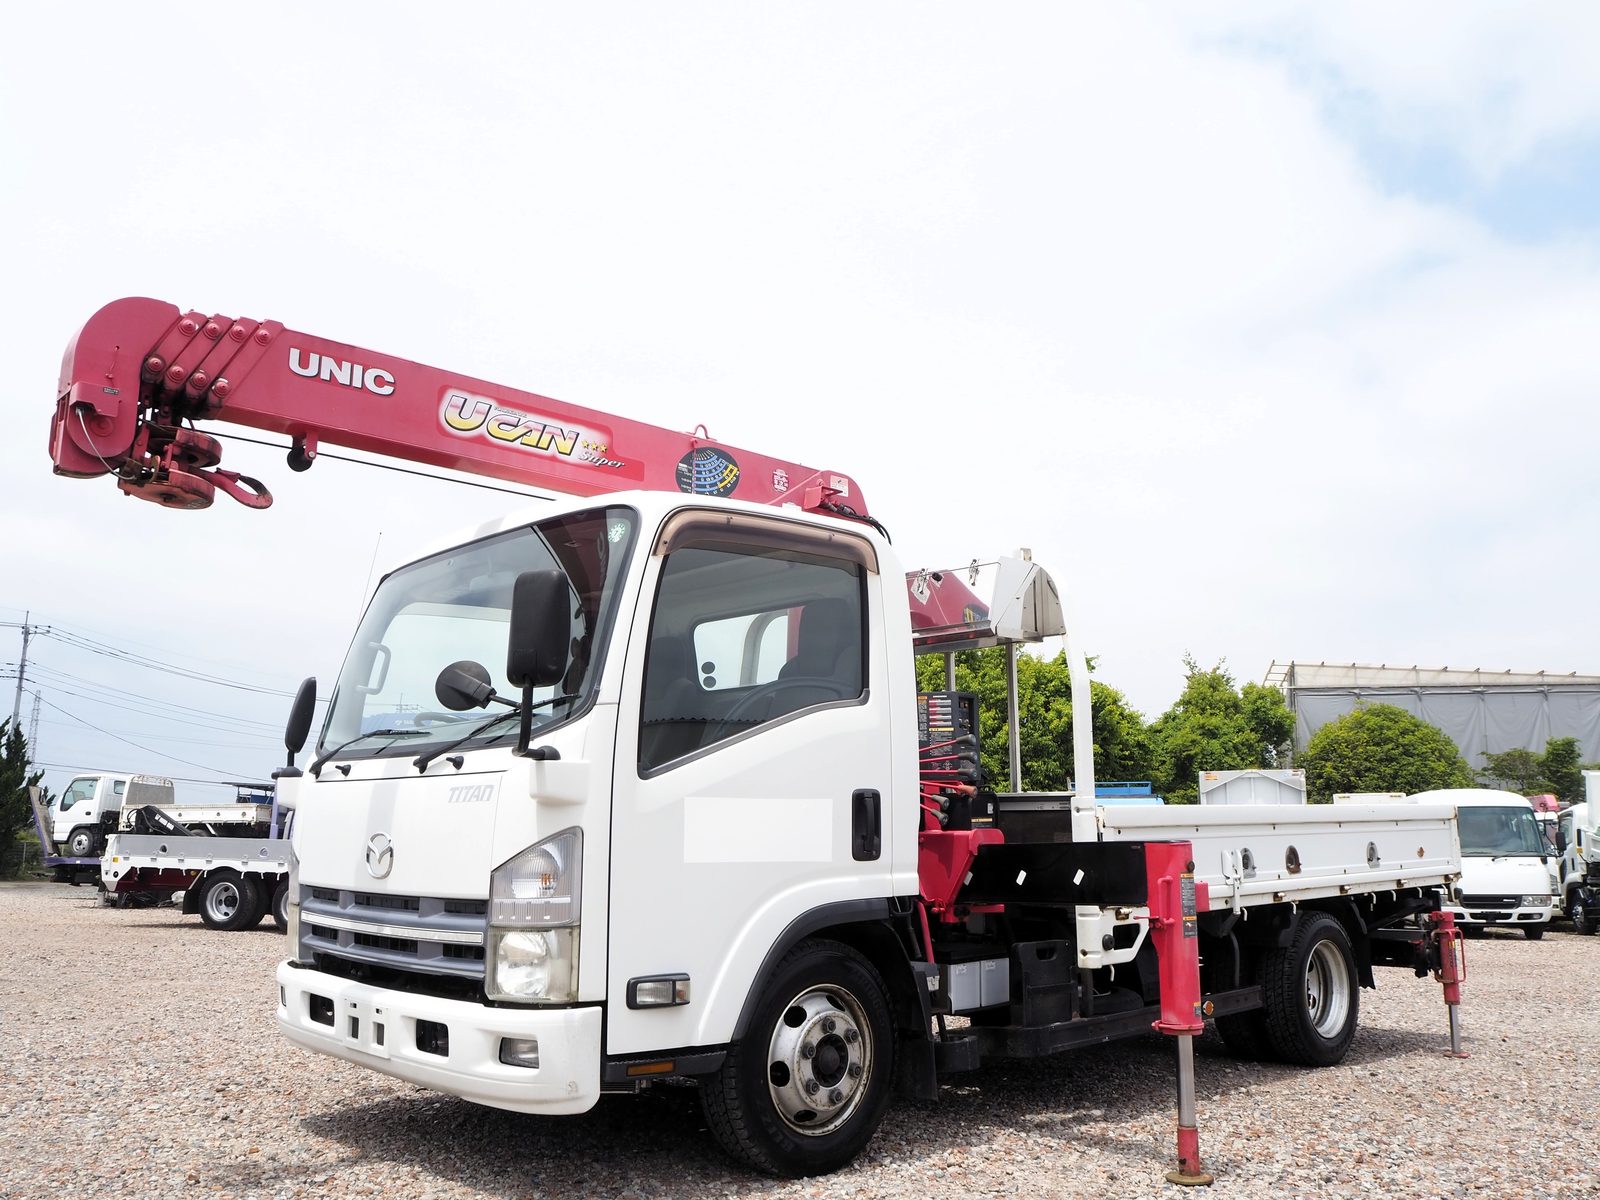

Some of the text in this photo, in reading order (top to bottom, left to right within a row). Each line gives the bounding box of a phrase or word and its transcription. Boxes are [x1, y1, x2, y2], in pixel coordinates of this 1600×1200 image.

[288, 347, 396, 396] UNIC
[578, 451, 625, 469] Super
[448, 785, 495, 803] TITAN
